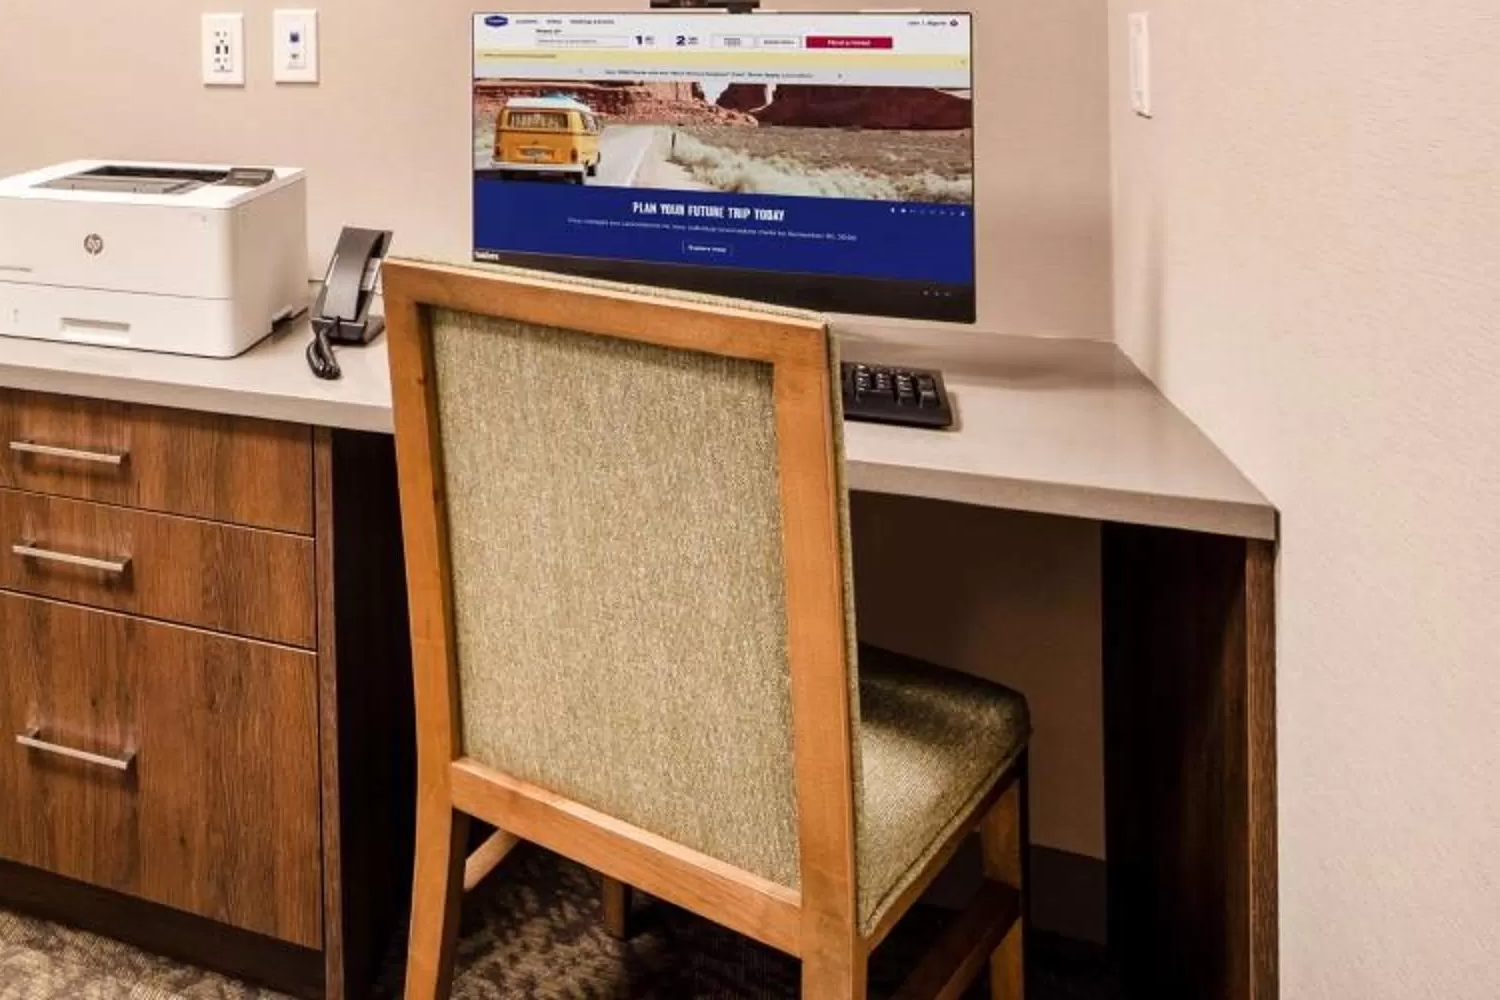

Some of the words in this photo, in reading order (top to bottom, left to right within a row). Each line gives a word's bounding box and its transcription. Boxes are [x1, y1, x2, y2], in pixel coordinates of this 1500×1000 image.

[635, 35, 643, 46] 1
[676, 35, 686, 46] 2
[632, 201, 657, 214] PLAN
[660, 202, 685, 216] YOUR
[687, 204, 725, 218] FUTURE
[728, 206, 751, 220] TRIP
[754, 208, 785, 222] TODAY
